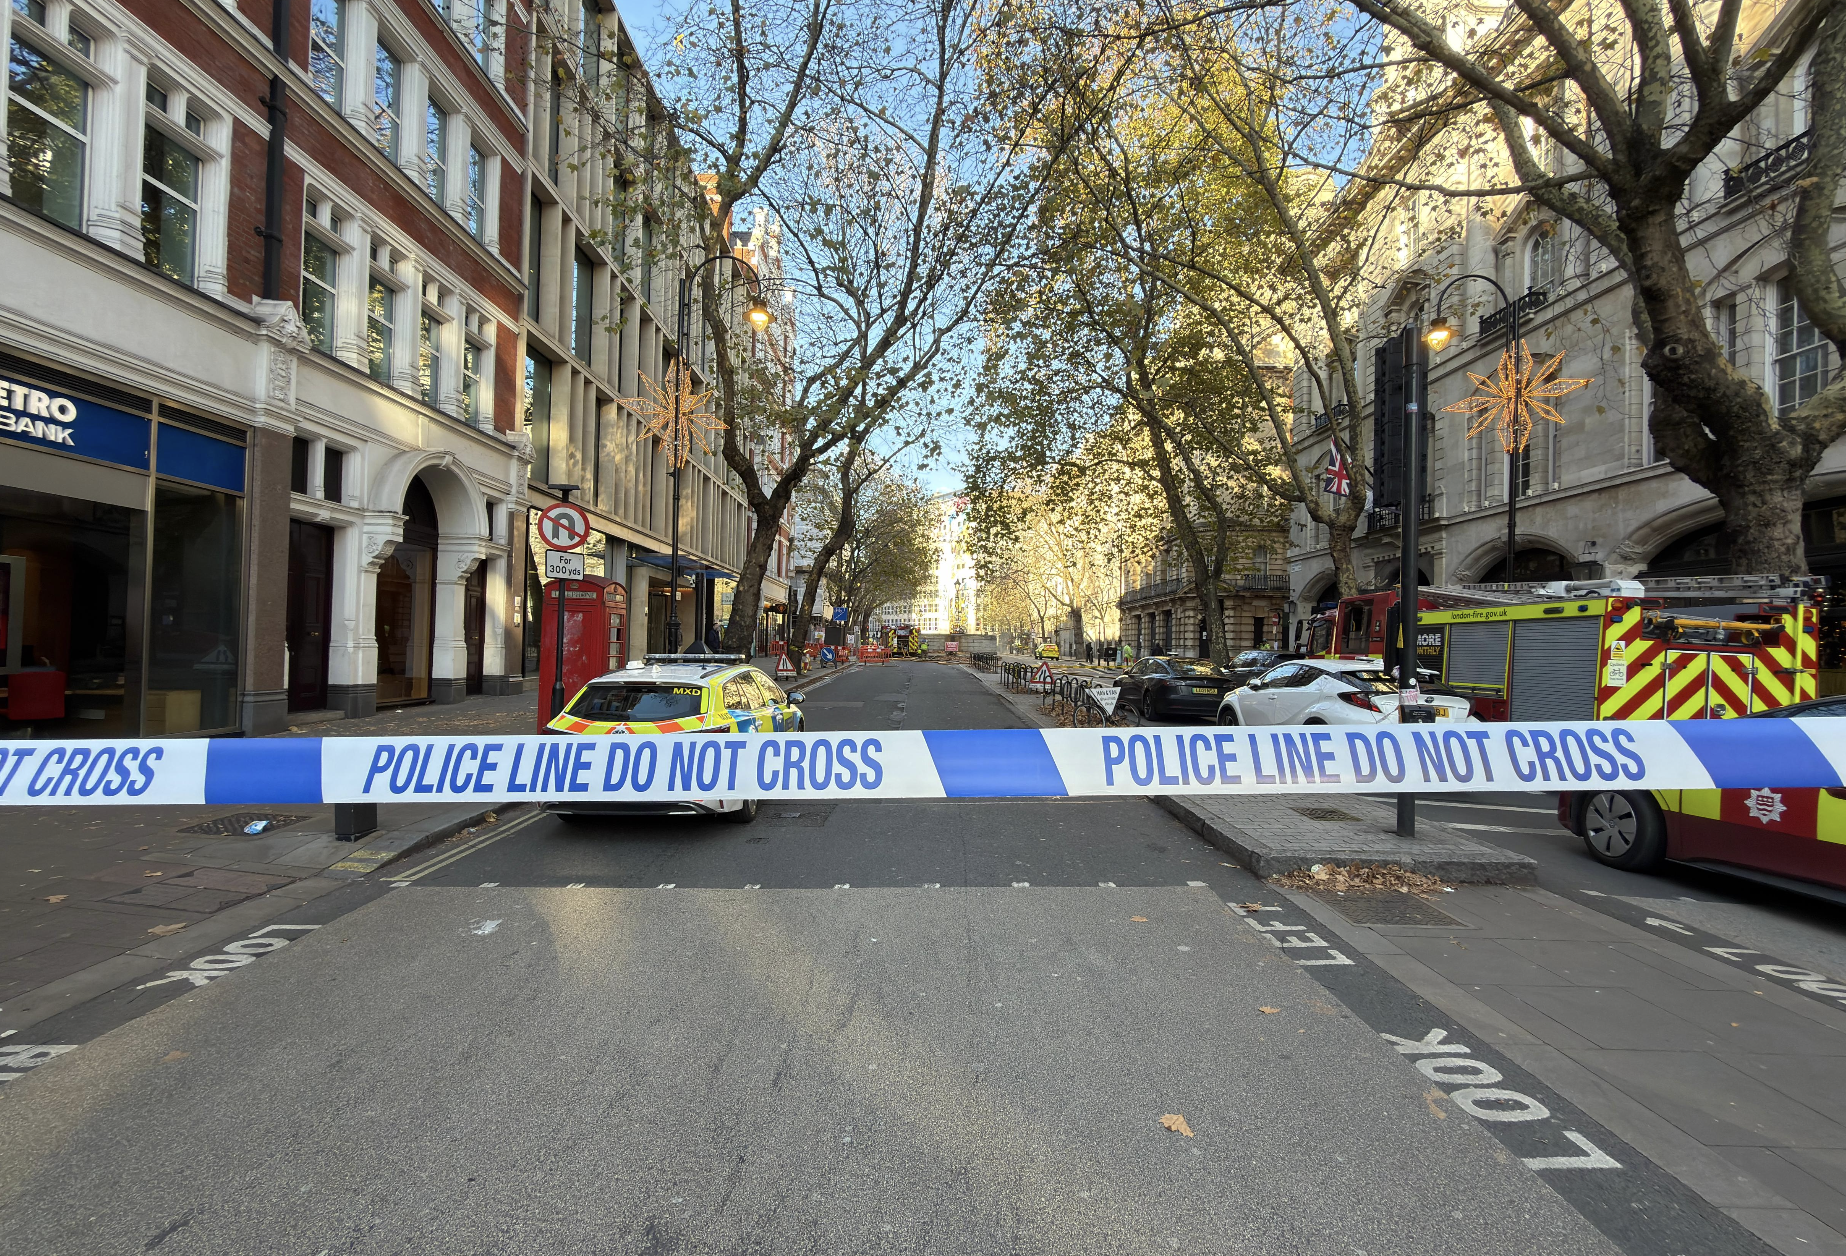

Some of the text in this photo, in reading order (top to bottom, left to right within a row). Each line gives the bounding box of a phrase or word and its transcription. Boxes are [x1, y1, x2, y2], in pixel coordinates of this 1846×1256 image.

[0, 411, 75, 446] BANK
[549, 565, 581, 576] 300 yds
[559, 555, 572, 564] For
[1451, 608, 1508, 620] london-fire.gov.uk
[673, 687, 701, 696] MXD
[27, 746, 164, 797] CROSS
[362, 738, 884, 794] POLICE LINE DO NOT CROSS
[1101, 727, 1646, 786] POLICE LINE DO NOT CROSS
[136, 924, 322, 989] LOOK
[1225, 902, 1623, 1171] LOOK LEFT
